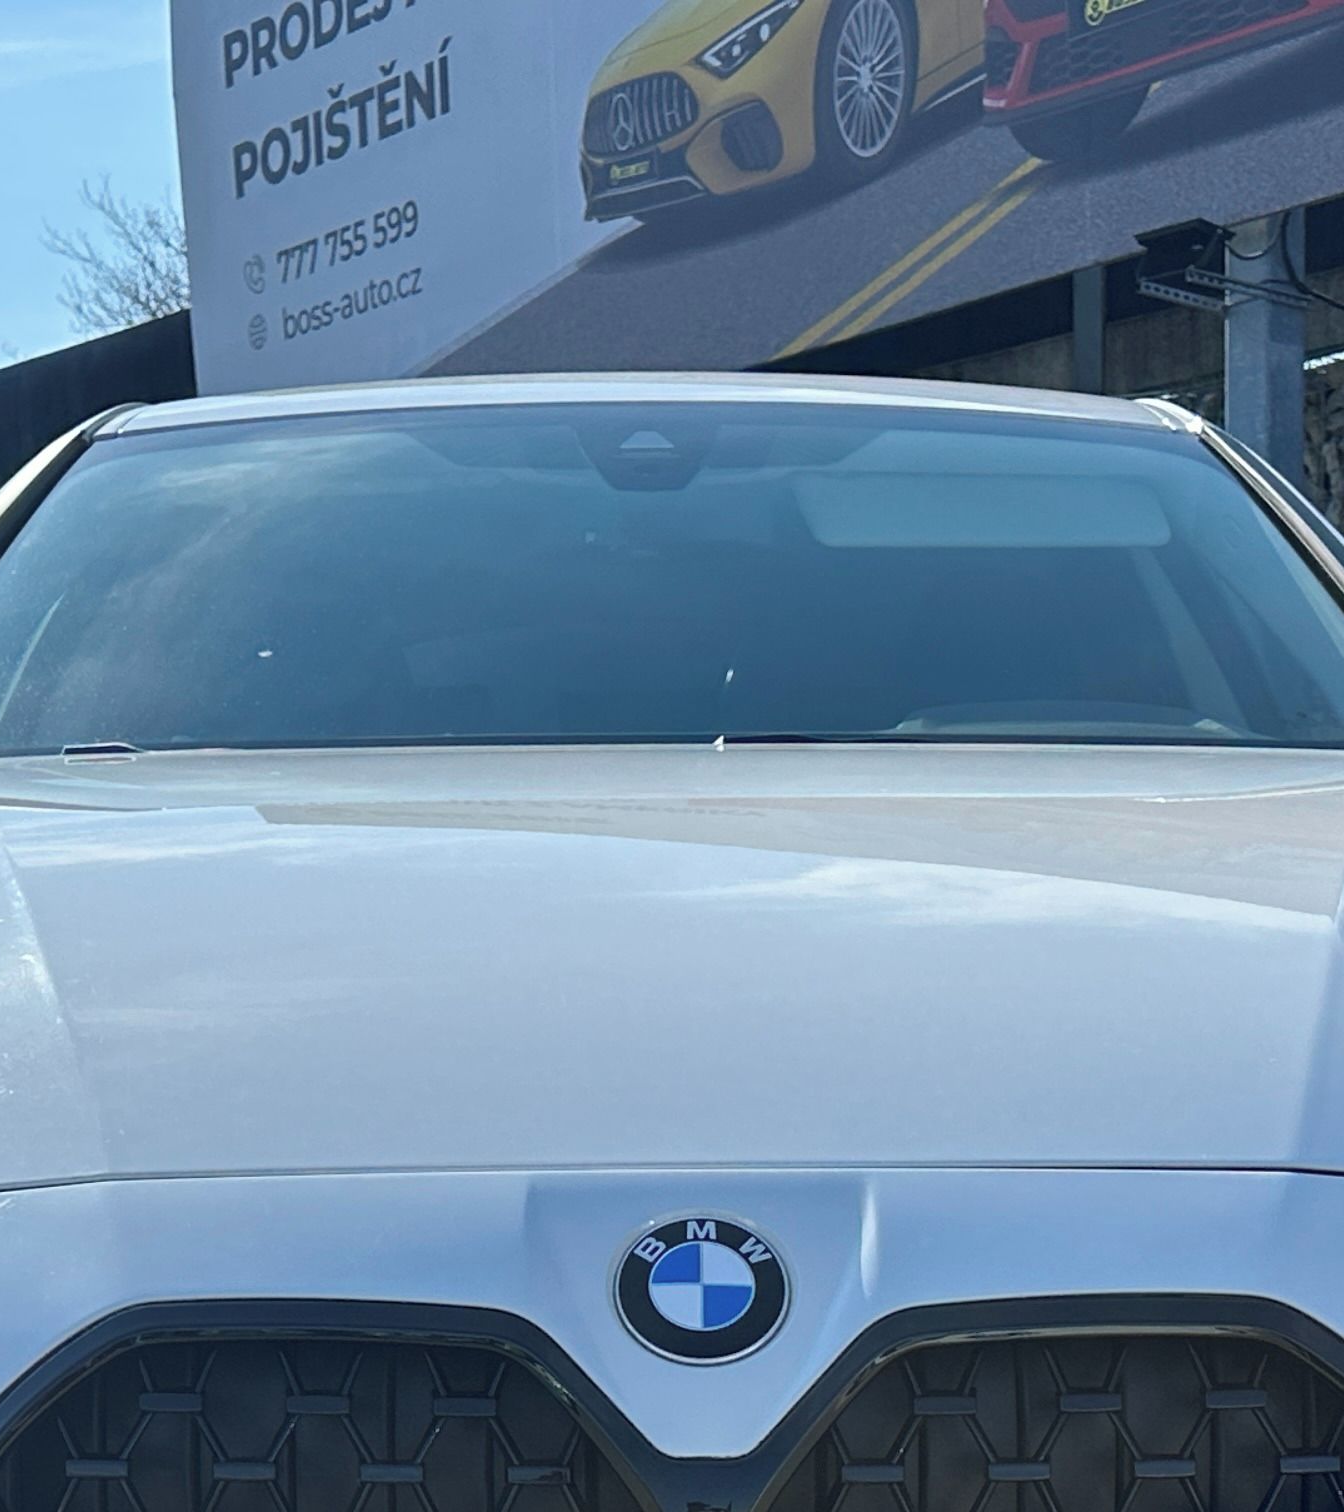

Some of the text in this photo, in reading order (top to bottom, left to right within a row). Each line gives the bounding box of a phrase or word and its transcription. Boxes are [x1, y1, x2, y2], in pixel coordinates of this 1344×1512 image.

[233, 36, 452, 199] POJIŠTĚNÍ
[277, 200, 419, 283] 777 755 599
[282, 267, 423, 339] boss-auto.cz
[633, 1220, 772, 1264] BMW
